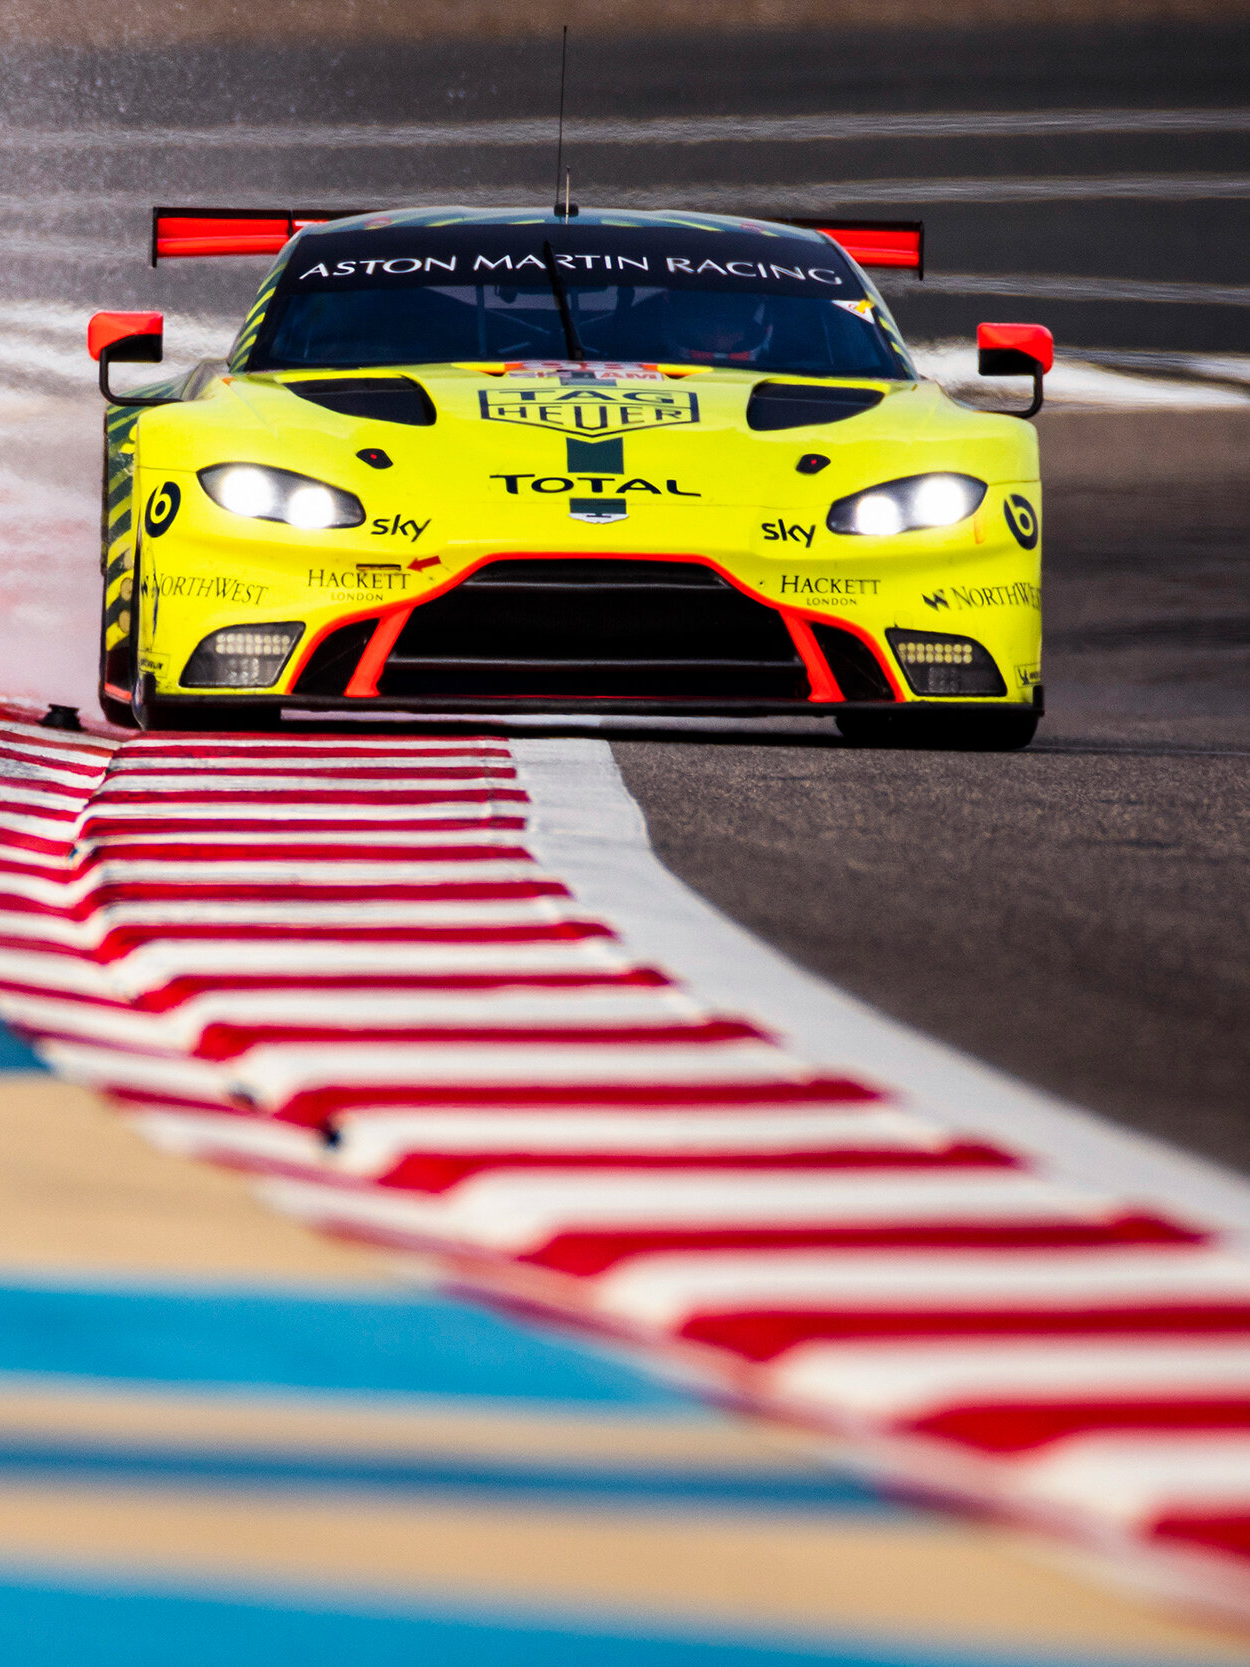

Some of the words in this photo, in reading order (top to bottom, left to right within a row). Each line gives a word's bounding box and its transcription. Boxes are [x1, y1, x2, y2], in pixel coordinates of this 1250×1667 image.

[299, 254, 457, 280] ASTON
[473, 253, 649, 271] MARTIN
[666, 257, 843, 285] RACING
[499, 389, 675, 404] TAG
[497, 405, 683, 431] HEUER
[489, 473, 702, 498] TOTAL
[370, 513, 432, 543] sky
[761, 518, 816, 548] sky
[150, 572, 269, 606] NORTHWEST
[308, 569, 411, 590] HACKETT
[780, 574, 882, 595] HACKETT
[330, 591, 384, 602] LONDON
[806, 597, 858, 607] LONDON
